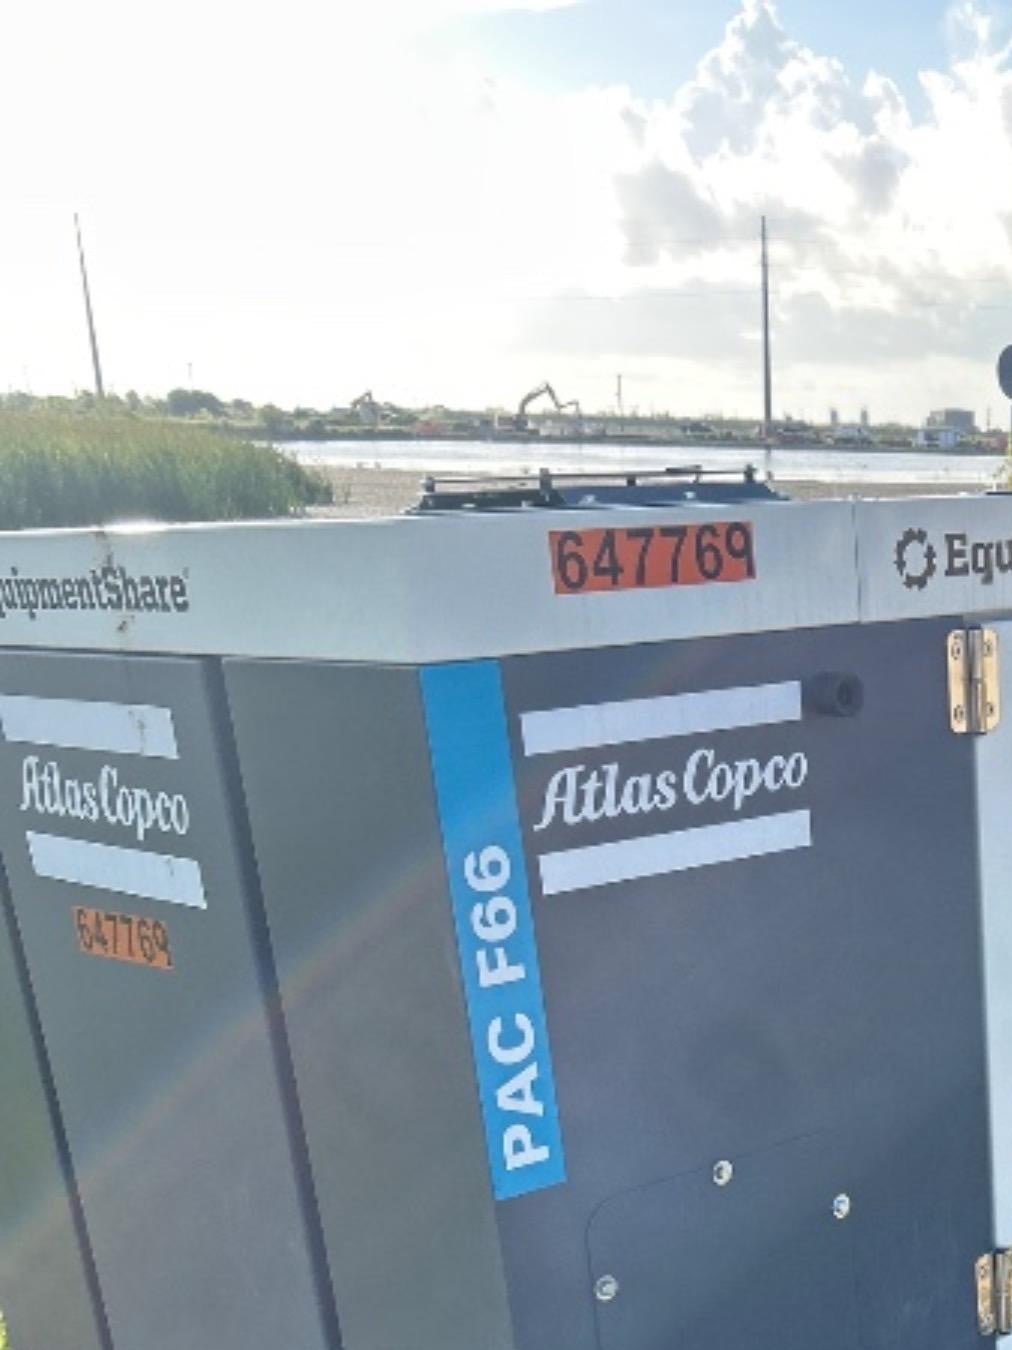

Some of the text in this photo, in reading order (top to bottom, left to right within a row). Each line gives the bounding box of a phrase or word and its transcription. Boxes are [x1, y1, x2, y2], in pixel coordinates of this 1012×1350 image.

[0, 565, 190, 620] uipmentShare
[556, 521, 755, 590] 647769
[20, 755, 190, 841] Atlas Copco
[533, 748, 809, 832] Atlas Copco
[76, 907, 172, 967] 647769
[463, 845, 551, 1172] PAC F66
